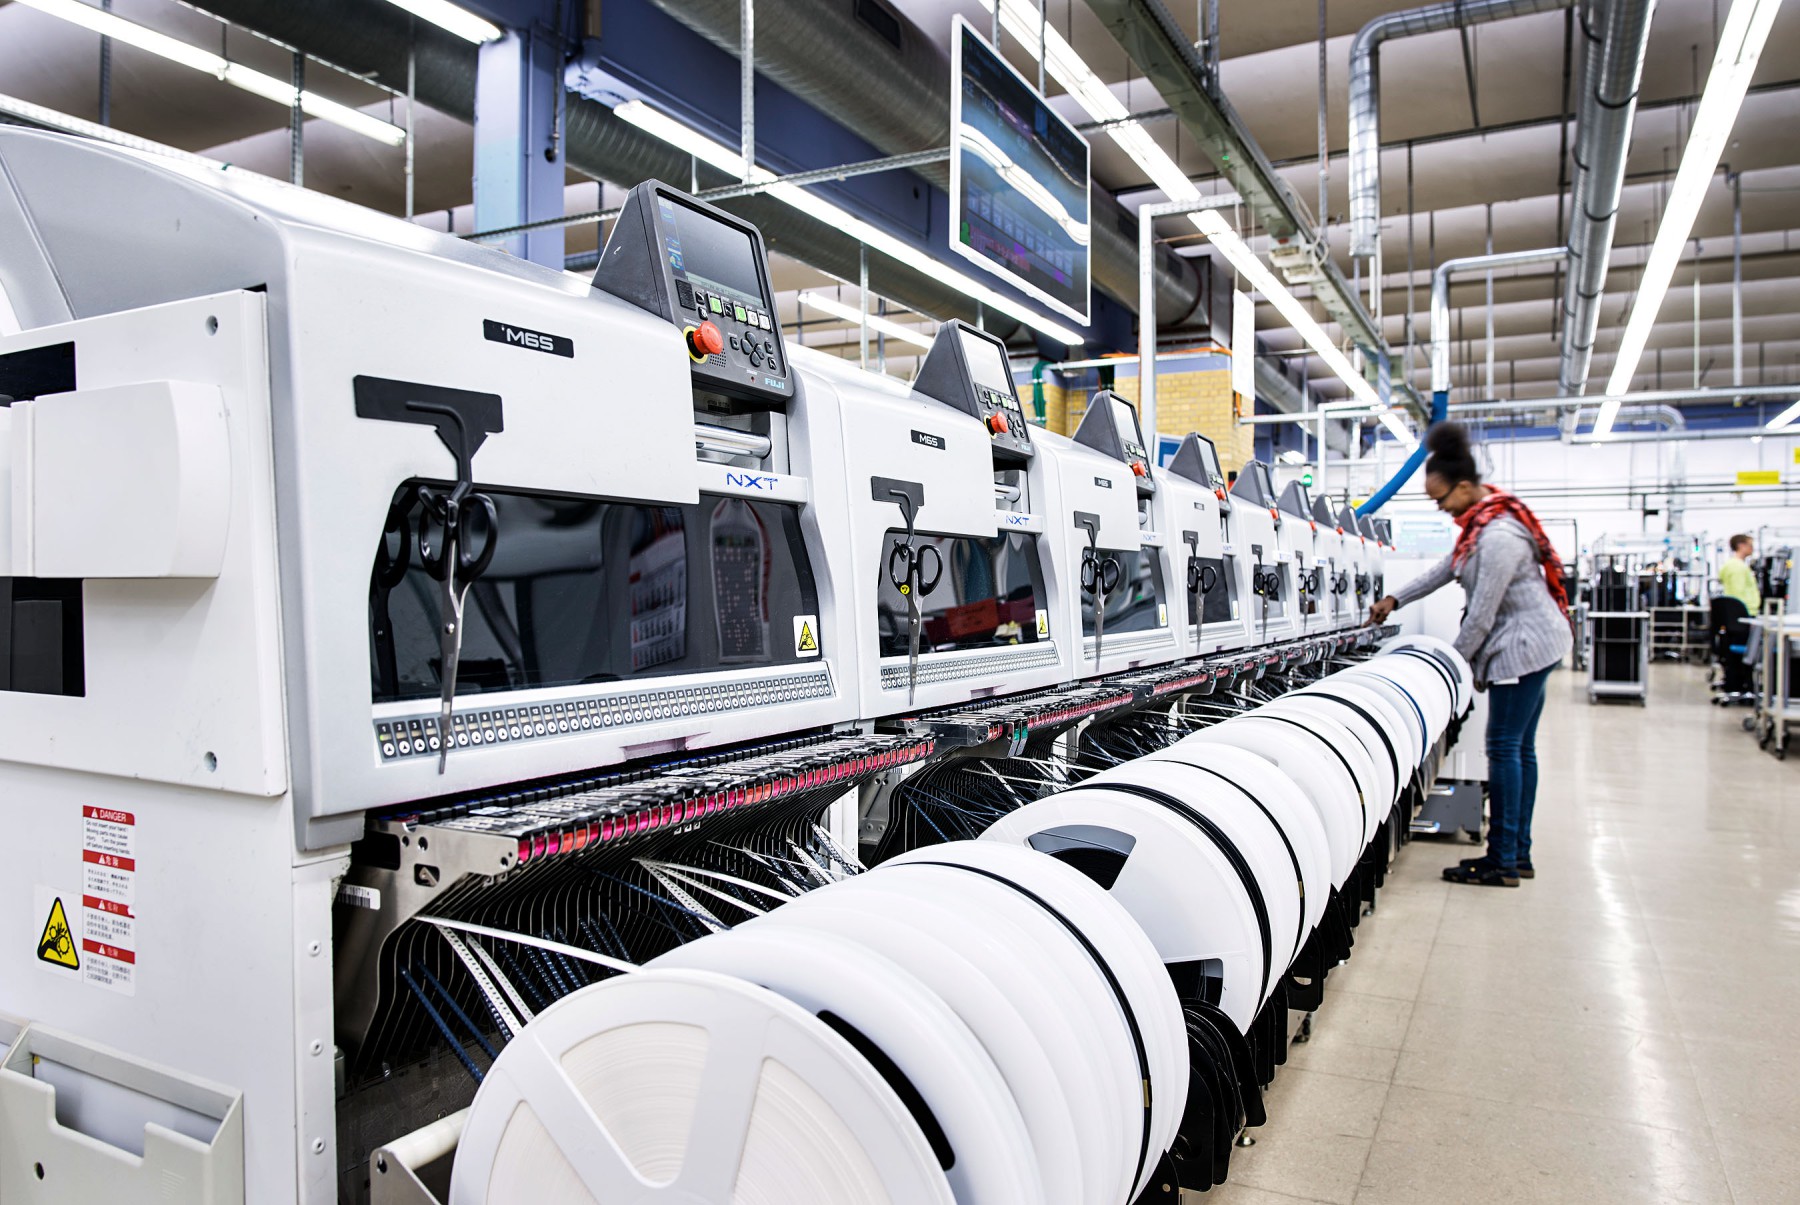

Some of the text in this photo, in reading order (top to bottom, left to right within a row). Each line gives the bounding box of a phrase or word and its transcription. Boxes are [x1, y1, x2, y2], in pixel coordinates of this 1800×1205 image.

[506, 328, 554, 350] M6S
[765, 378, 784, 390] FUJI
[920, 434, 938, 446] M6S
[726, 472, 778, 490] NXT
[1006, 516, 1030, 526] NXT
[100, 810, 126, 822] DANGER
